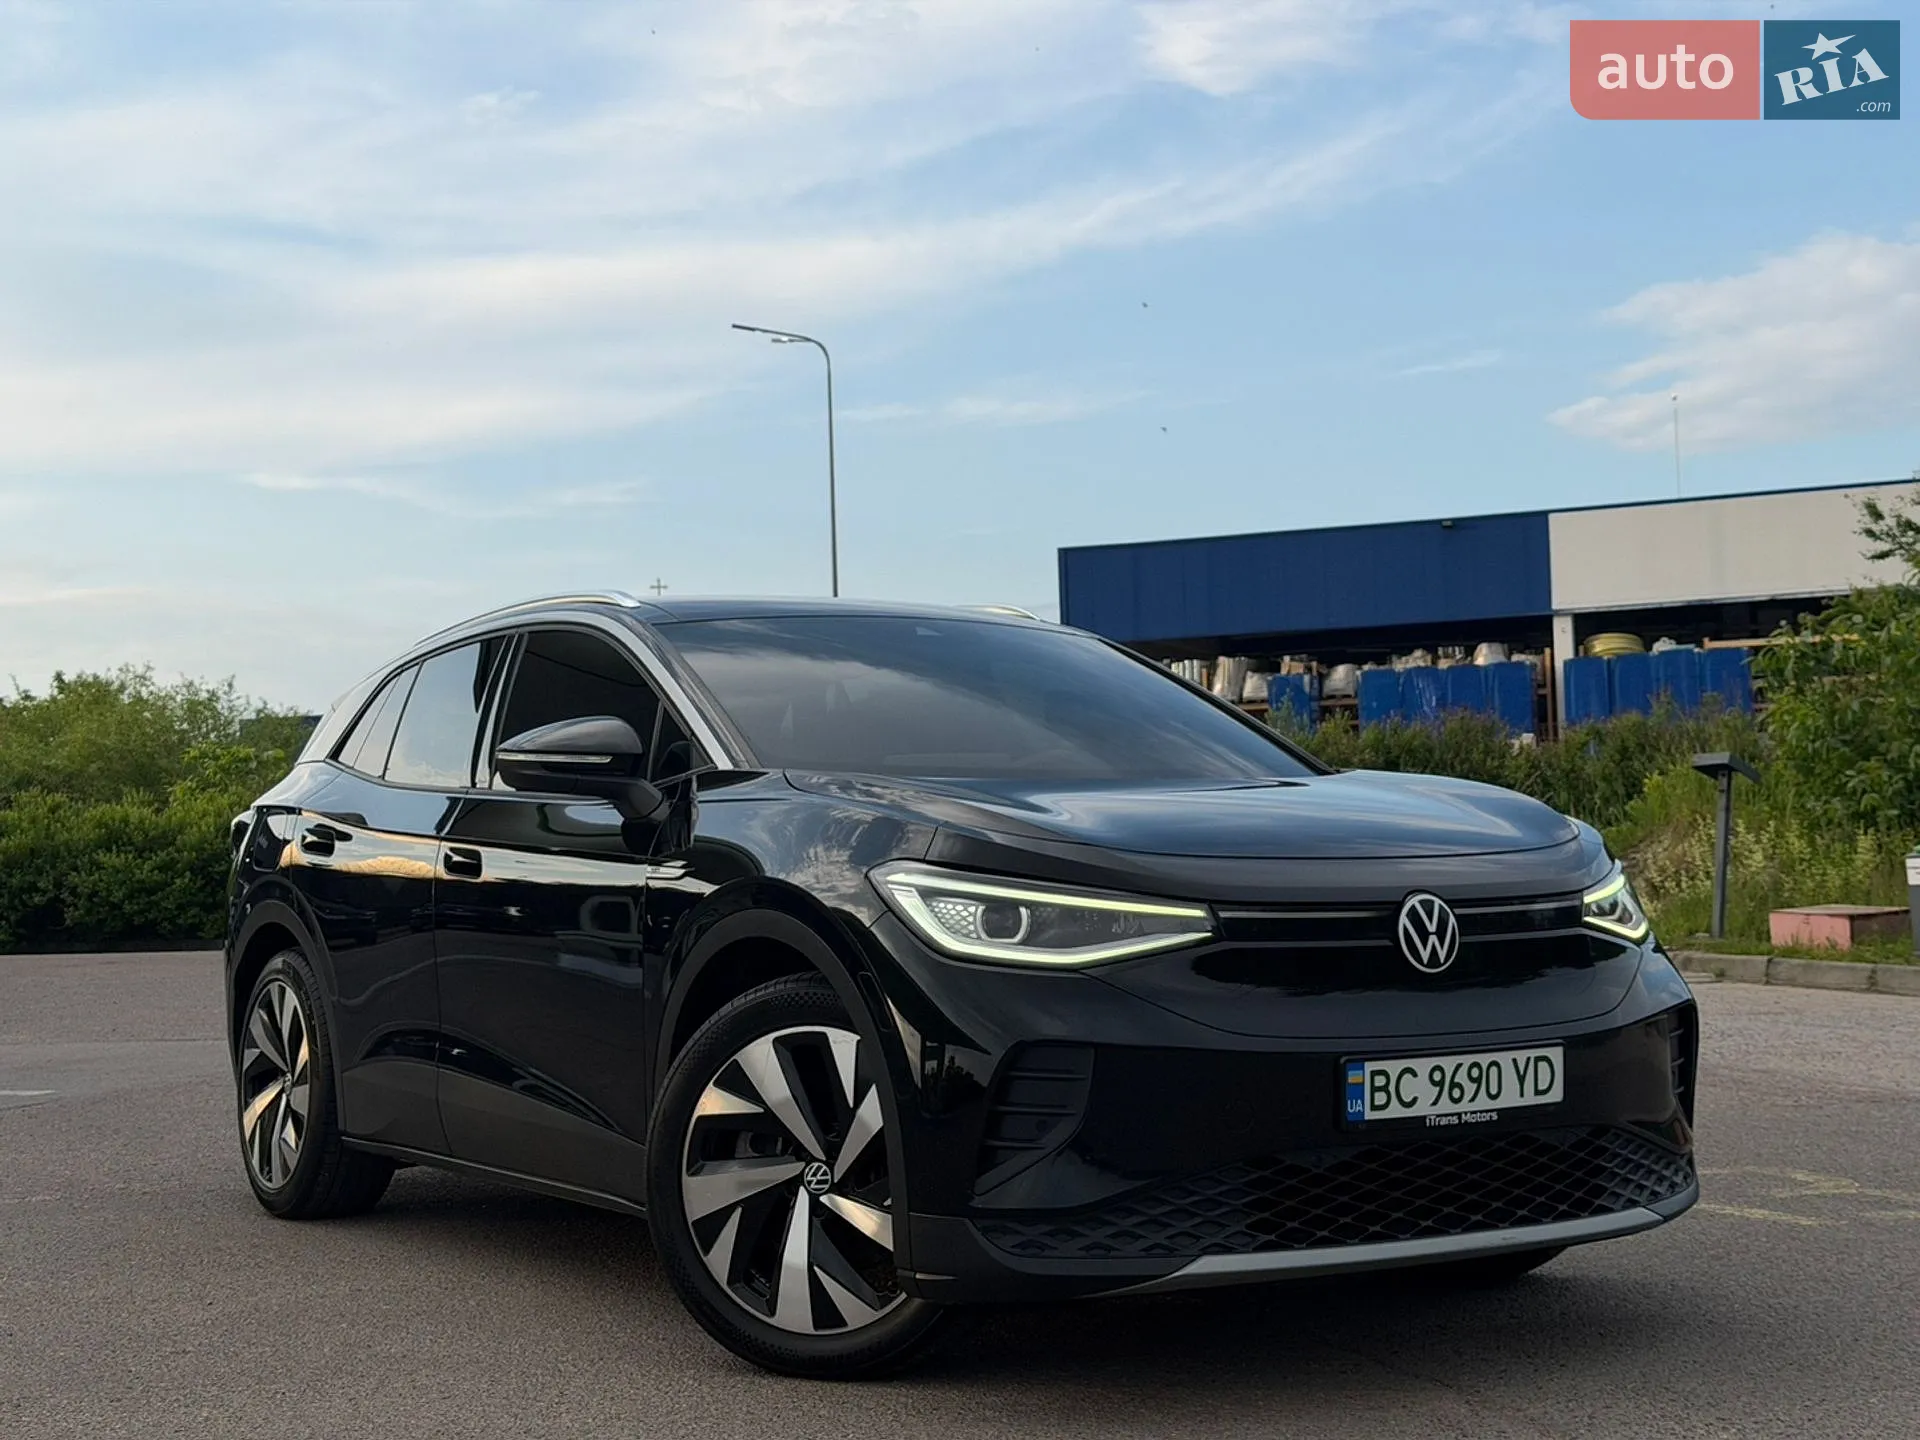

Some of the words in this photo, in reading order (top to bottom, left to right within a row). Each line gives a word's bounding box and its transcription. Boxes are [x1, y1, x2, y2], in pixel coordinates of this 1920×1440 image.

[1369, 1066, 1419, 1112] BC
[1427, 1059, 1503, 1107] 9690
[1511, 1054, 1556, 1098] YD
[1347, 1099, 1364, 1113] UA
[1461, 1110, 1499, 1124] Motors
